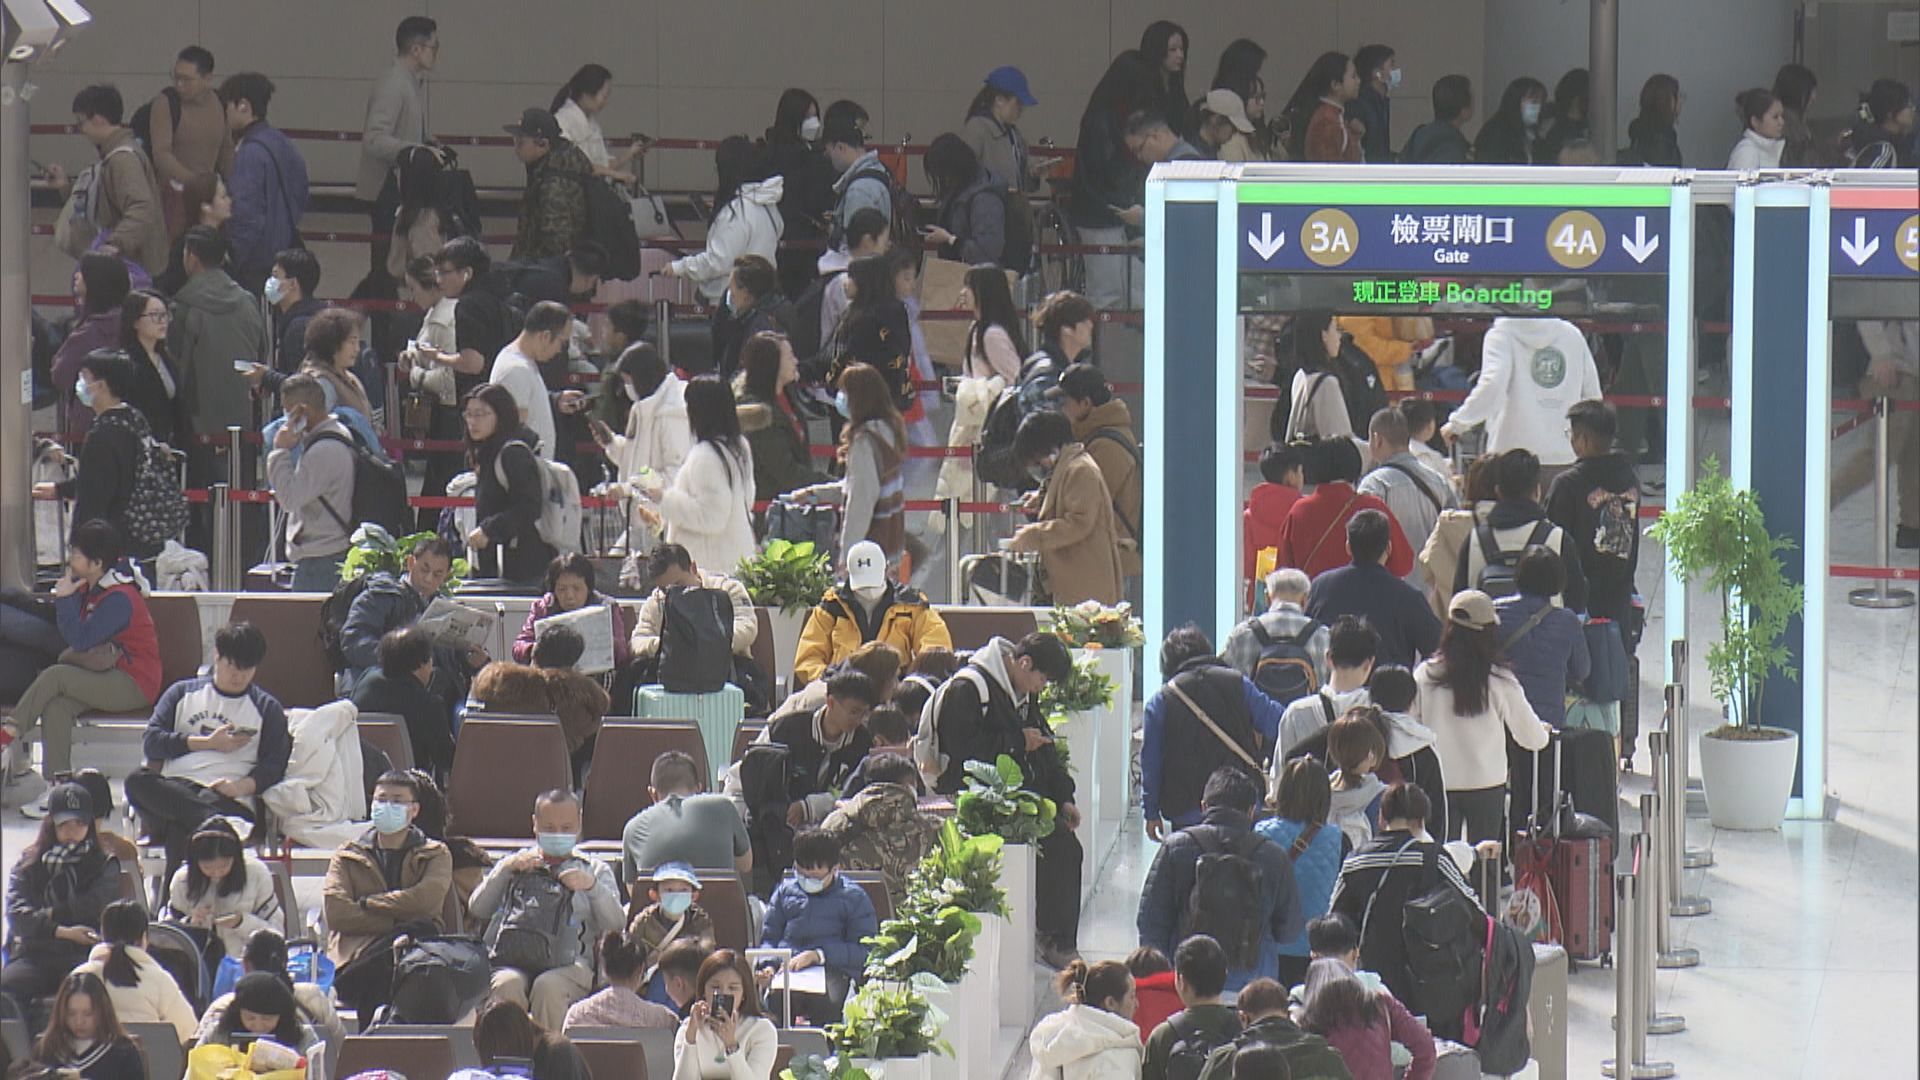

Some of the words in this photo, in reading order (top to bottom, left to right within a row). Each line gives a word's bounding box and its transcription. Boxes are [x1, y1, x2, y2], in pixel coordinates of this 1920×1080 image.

[1310, 220, 1351, 254] 3A
[1390, 213, 1514, 245] 檢票閘口
[1553, 222, 1598, 256] 4A
[1434, 249, 1470, 264] Gate
[1353, 280, 1441, 304] 現正登車
[1446, 283, 1552, 309] Boarding
